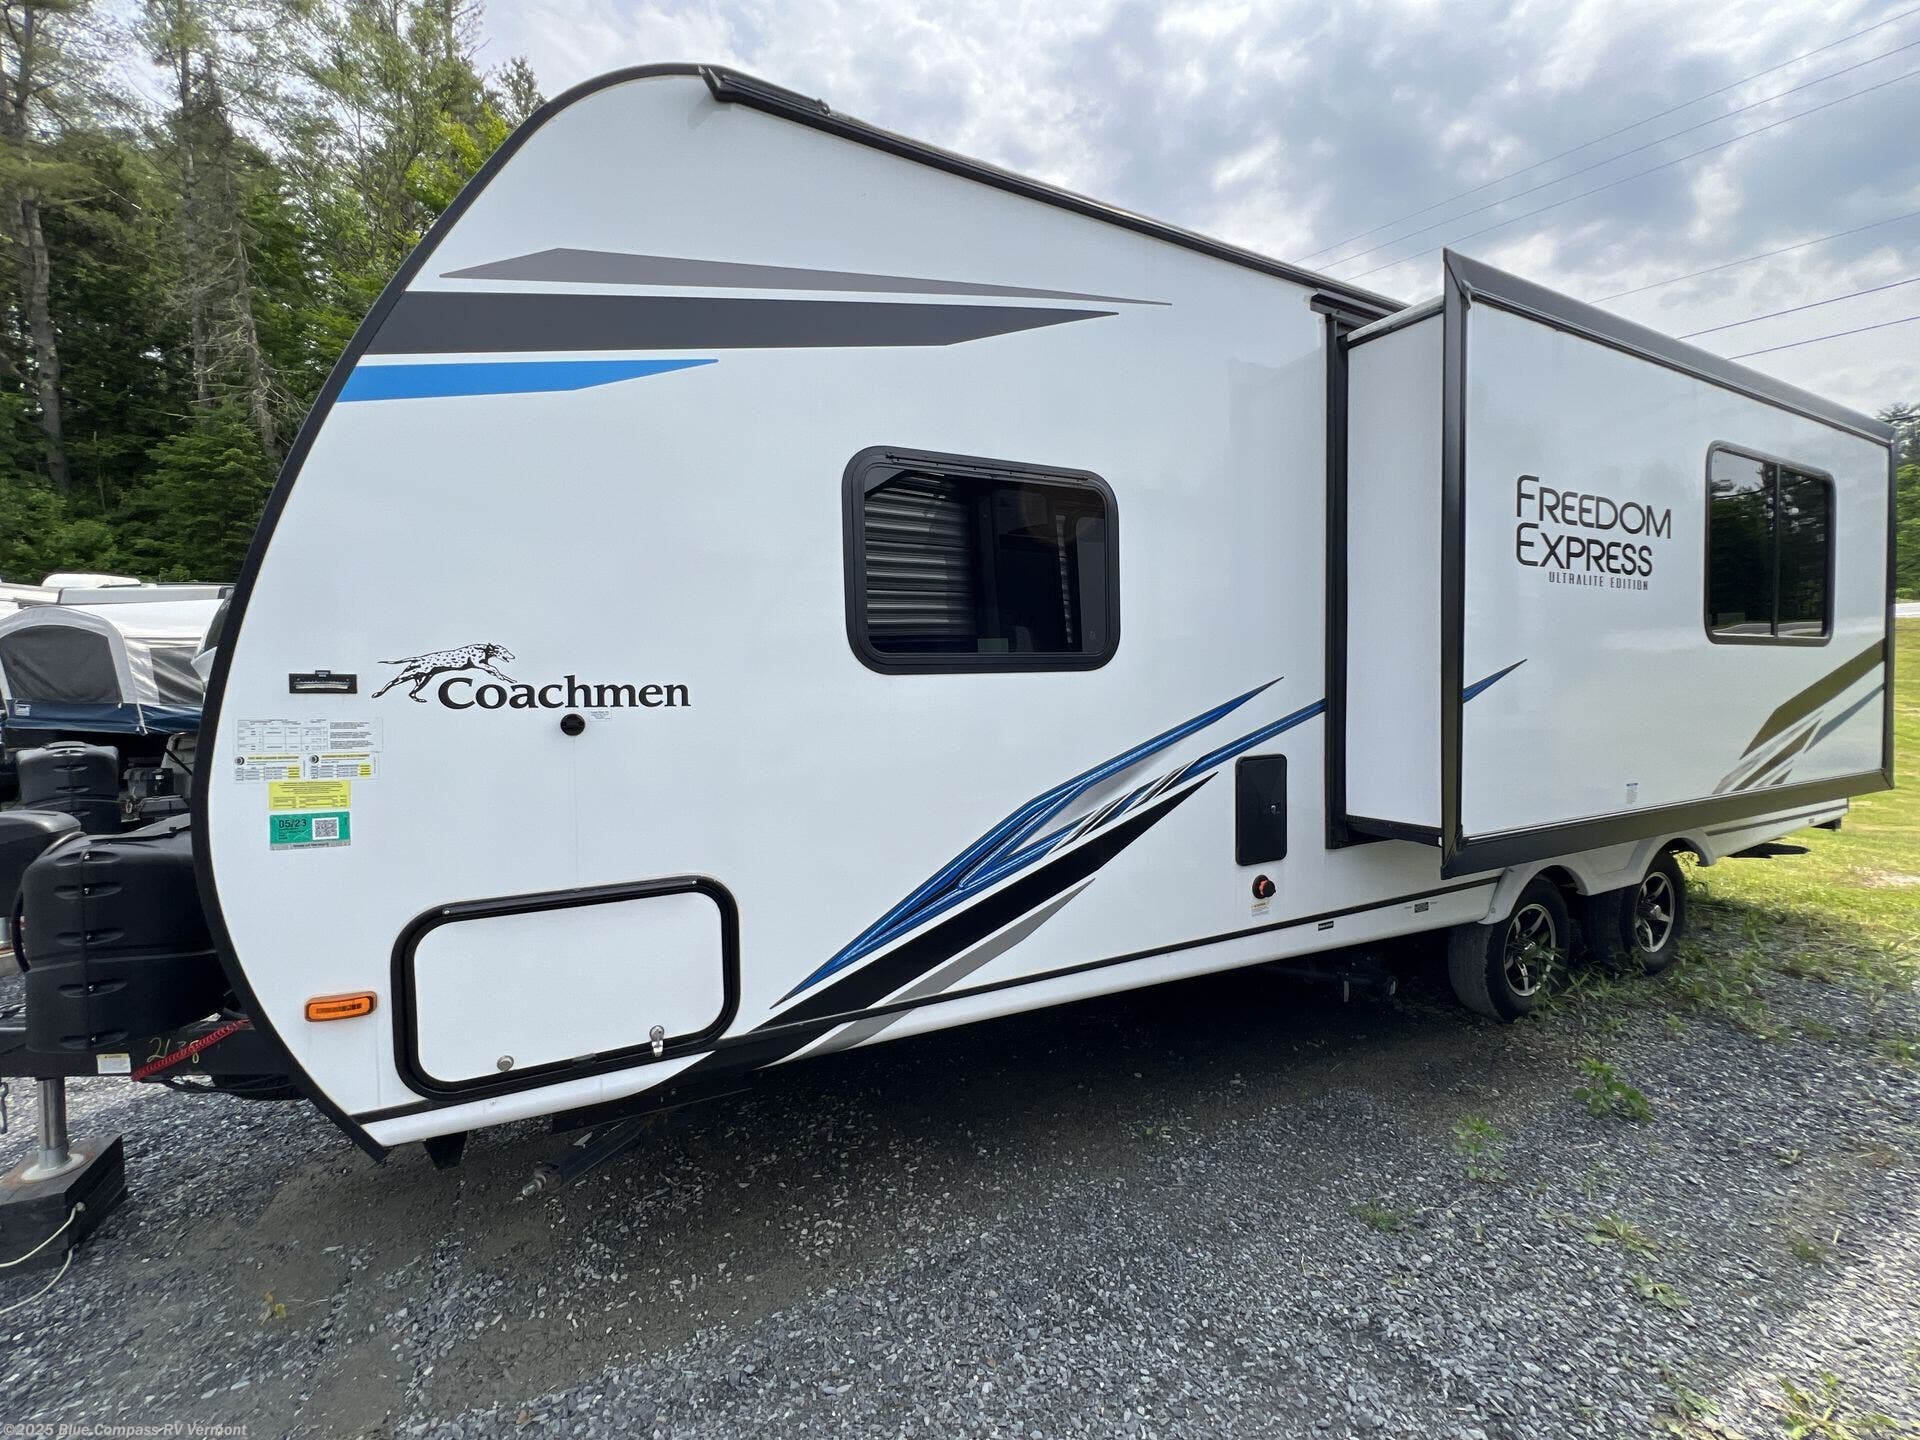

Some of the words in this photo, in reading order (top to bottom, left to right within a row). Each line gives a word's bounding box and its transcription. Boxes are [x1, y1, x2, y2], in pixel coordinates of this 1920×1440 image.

[1516, 475, 1671, 538] FREEDOM
[1516, 522, 1652, 576] EXPRESS
[1549, 571, 1604, 587] ULTRALITE
[1610, 577, 1648, 590] EDITION
[437, 674, 691, 710] Coachmen
[278, 818, 307, 829] 05/23
